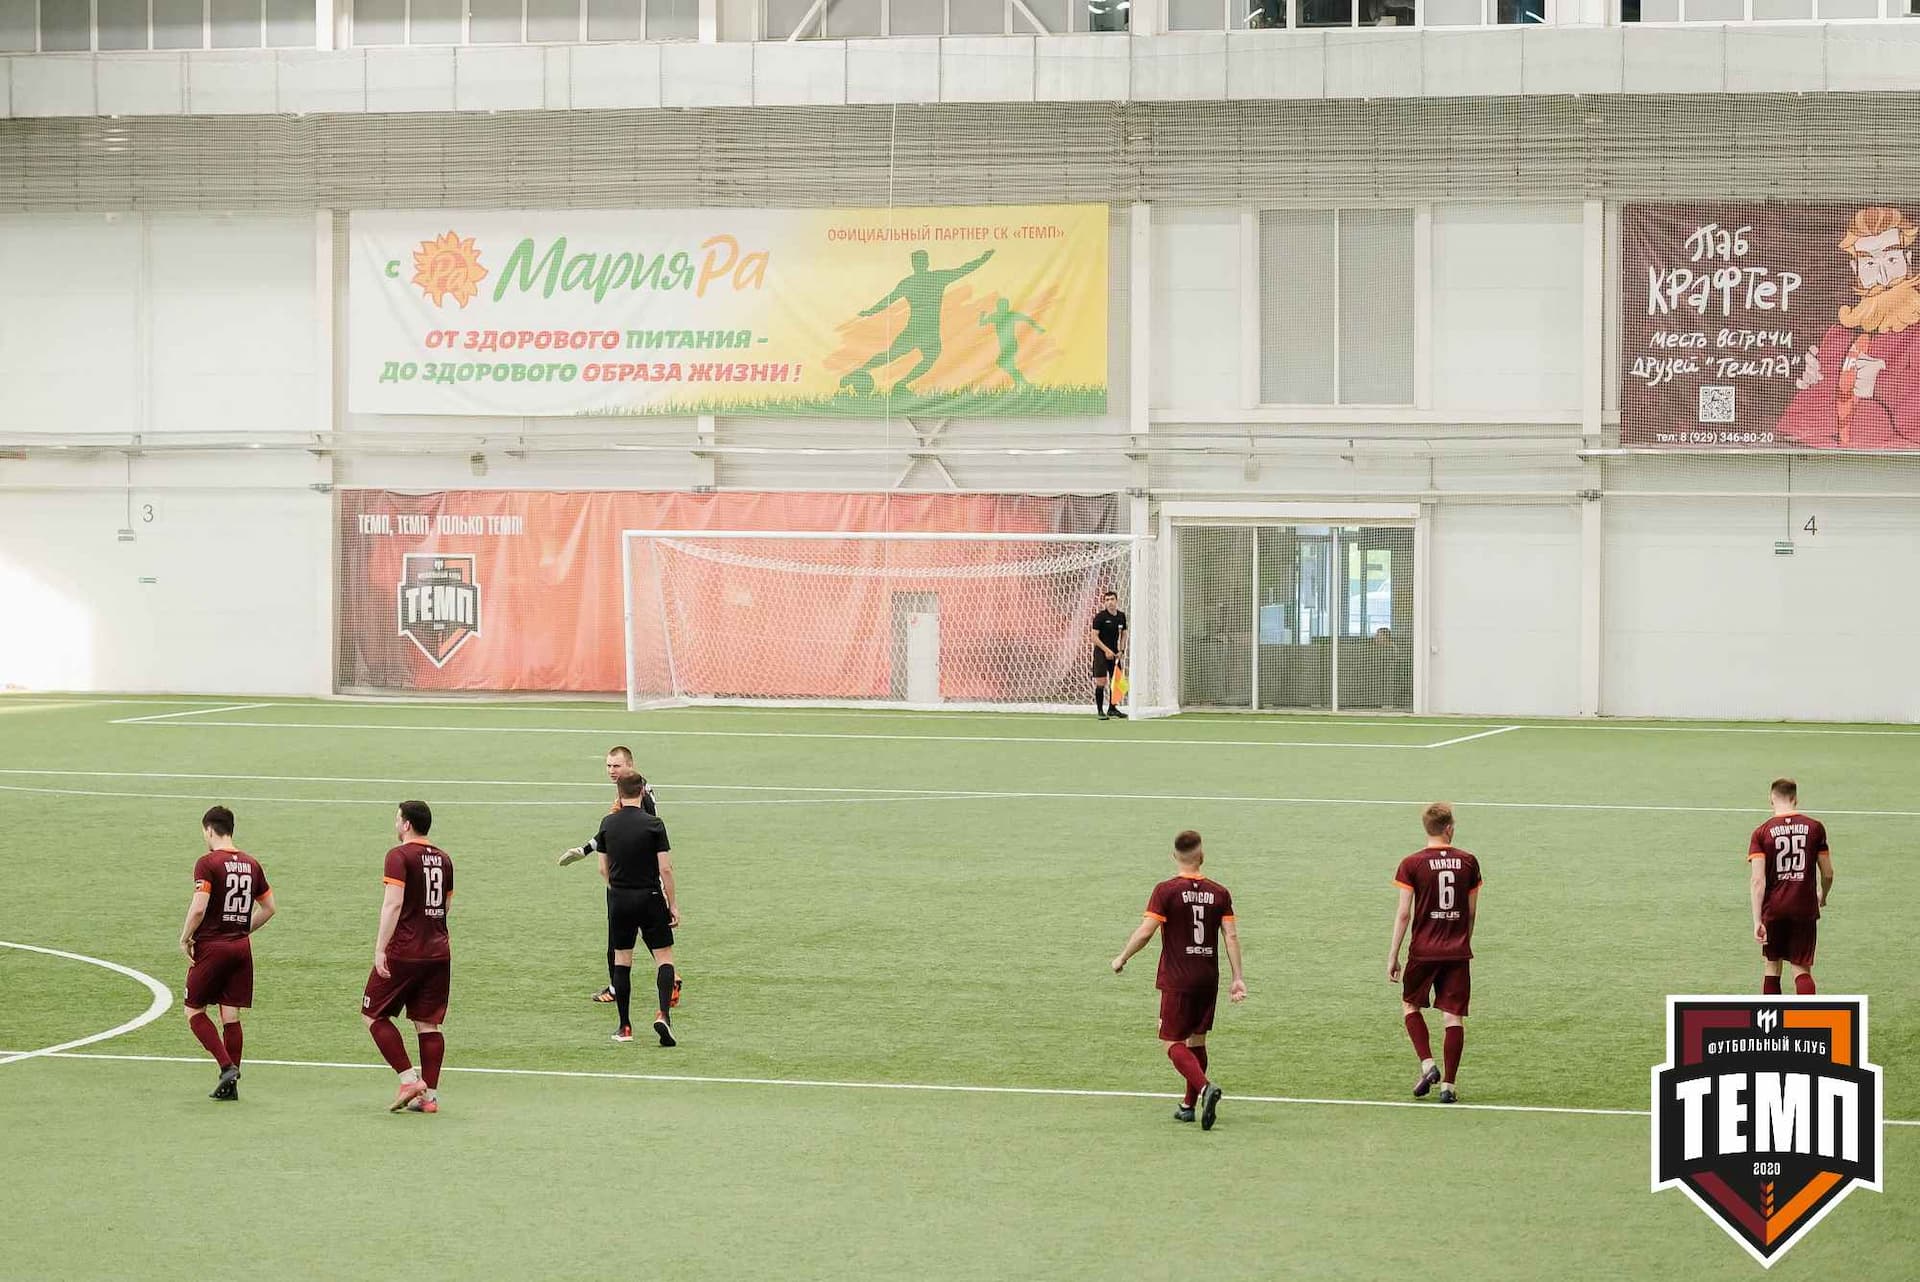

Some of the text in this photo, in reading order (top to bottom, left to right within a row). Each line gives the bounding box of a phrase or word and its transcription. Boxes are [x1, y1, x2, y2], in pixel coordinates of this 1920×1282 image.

[827, 224, 1065, 243] ОФИЦИАЛЬНЫЙ ПАРТНЕР СК «ТЕМП»
[1685, 223, 1751, 262] Паб
[425, 330, 459, 349] ОТ
[463, 329, 620, 352] ЗДОРОВОГО
[626, 329, 752, 349] ПИТАНИЯ
[379, 361, 418, 384] ДО
[422, 362, 577, 384] ЗДОРОВОГО
[582, 362, 682, 383] ОБРАЗА
[1681, 432, 1687, 441] 8
[1689, 432, 1717, 445] (929)
[1720, 432, 1774, 442] 346-80-20
[143, 504, 154, 523] 3
[436, 514, 484, 535] ТОЛЬКО
[1803, 515, 1818, 536] 4
[405, 585, 474, 625] ТЕМП
[1774, 834, 1807, 873] 25
[223, 873, 252, 914] 23
[423, 867, 443, 907] 13
[1438, 870, 1456, 910] 6
[1191, 904, 1205, 945] 5
